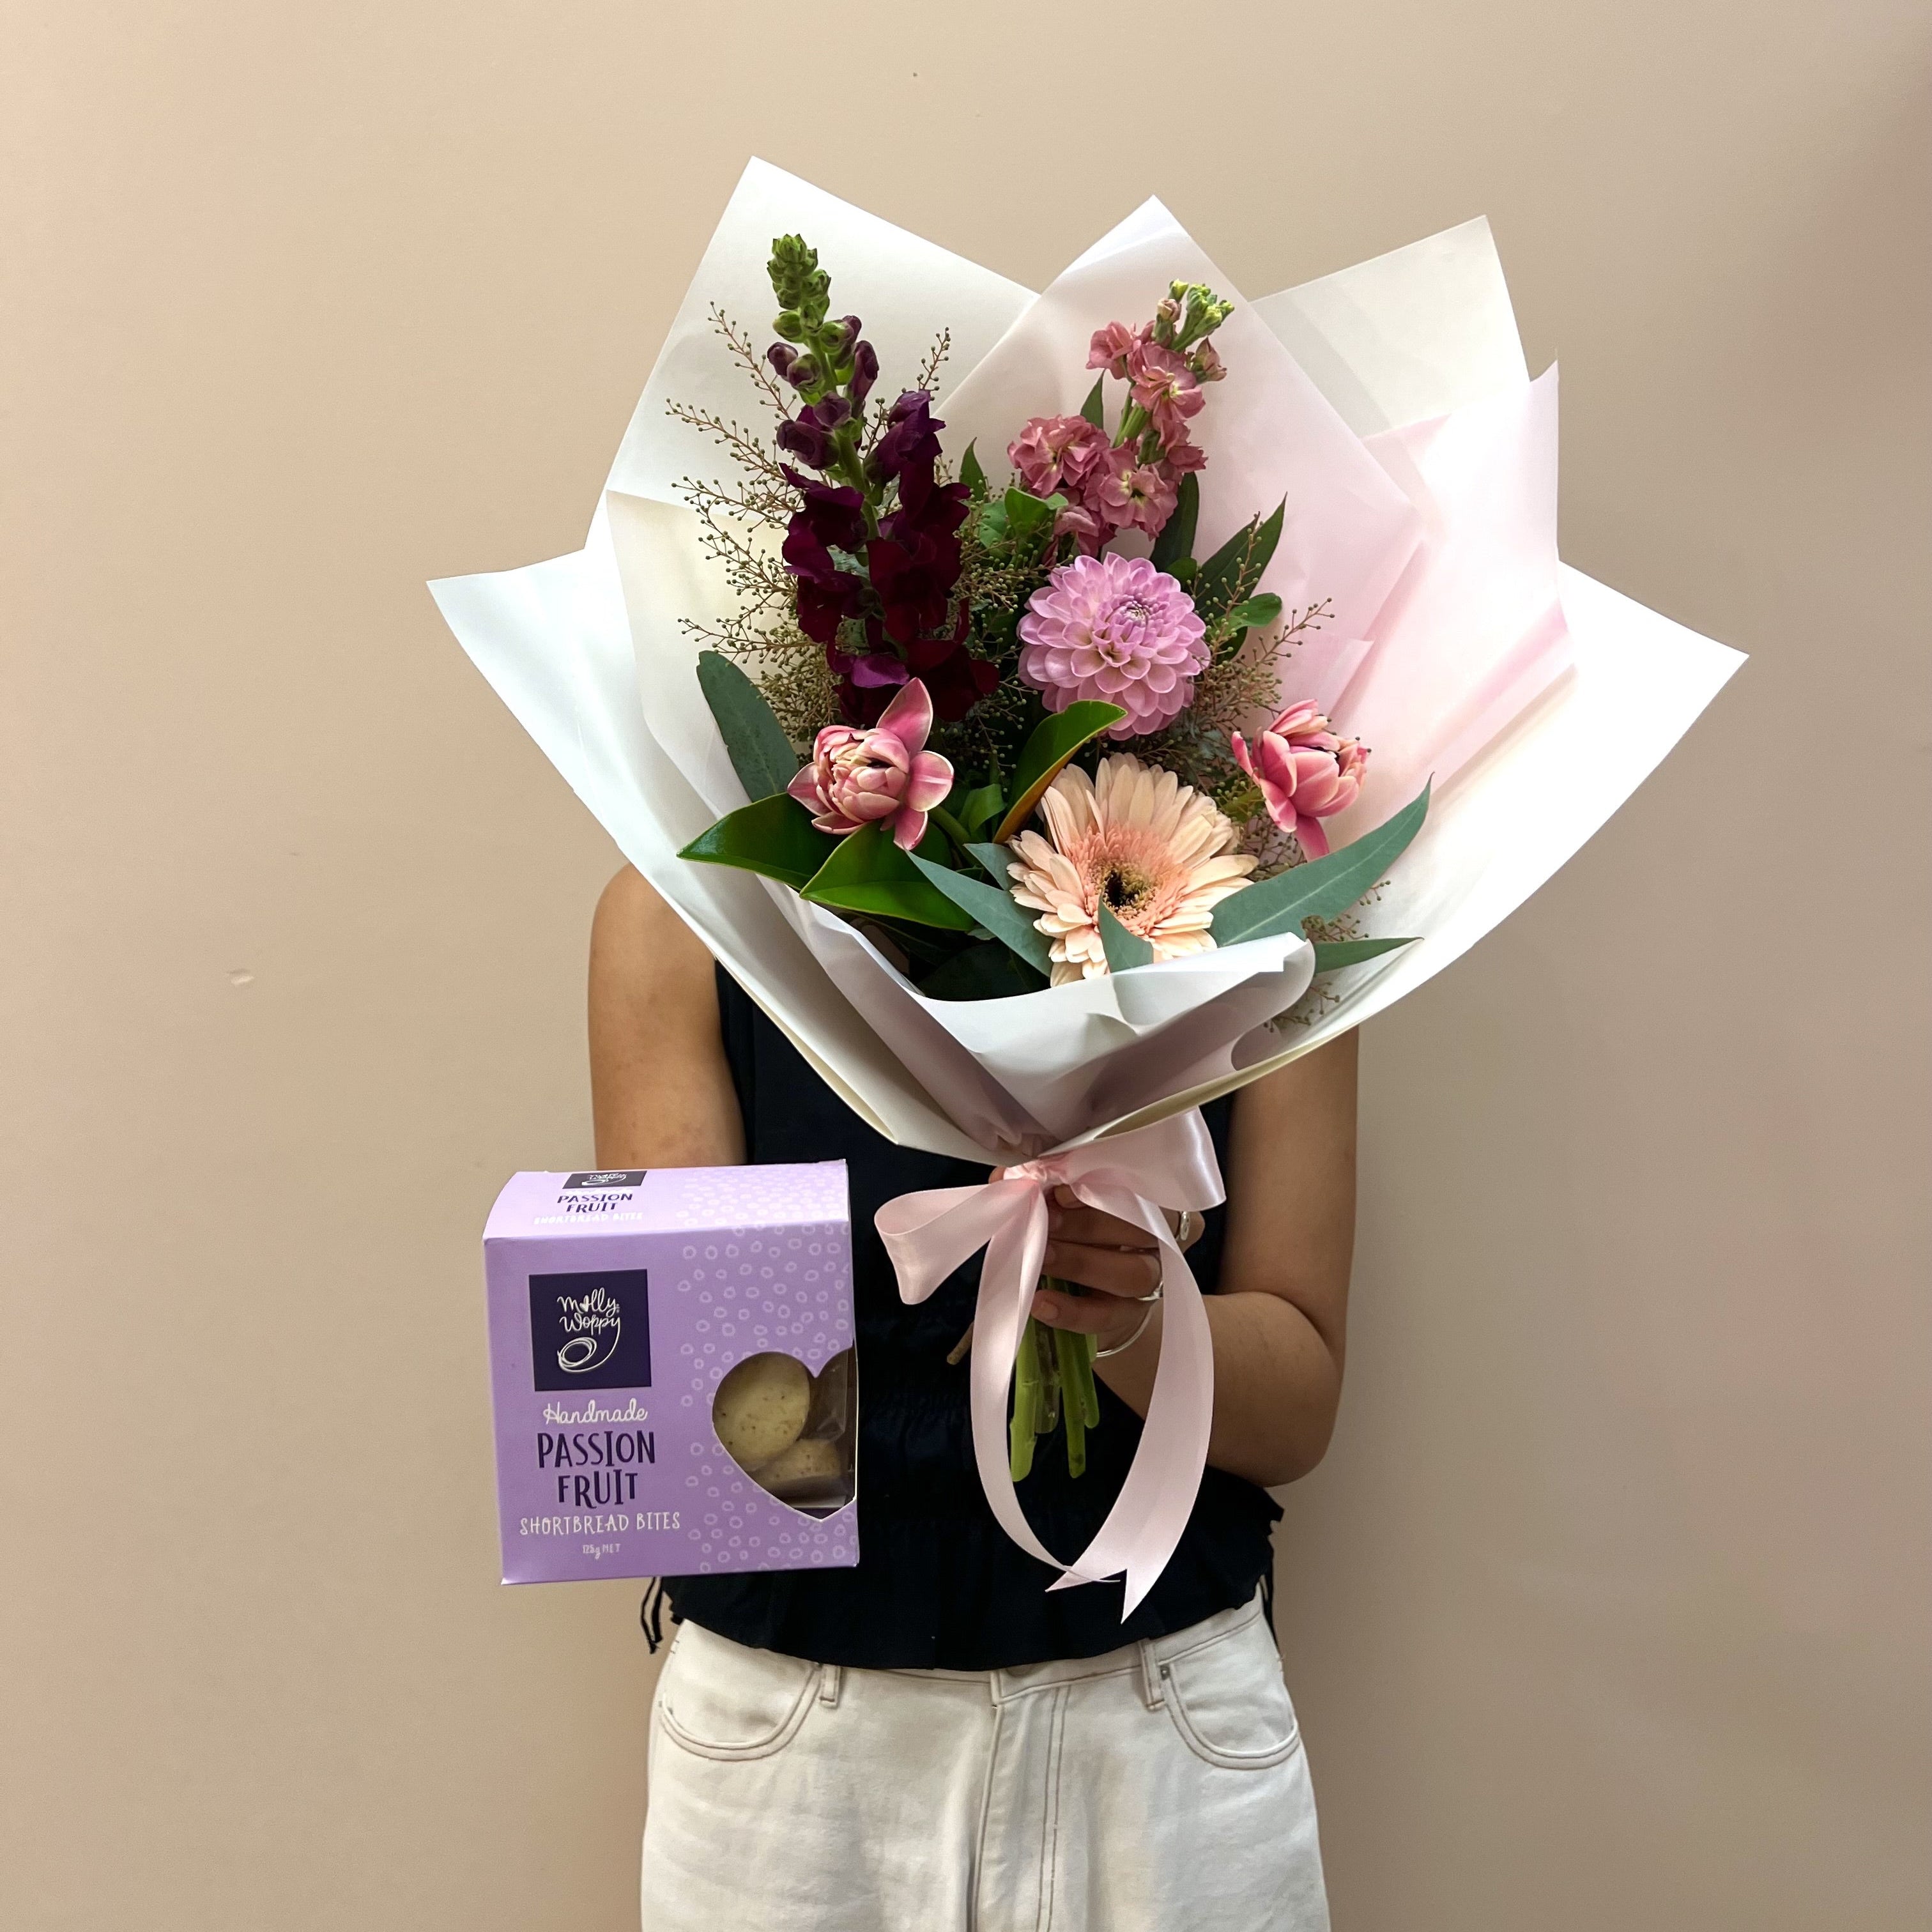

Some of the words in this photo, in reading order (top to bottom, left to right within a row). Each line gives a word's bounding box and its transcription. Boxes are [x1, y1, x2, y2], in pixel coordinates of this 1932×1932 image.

[557, 1193, 632, 1204] PASSION
[566, 1202, 618, 1213] FRUIT
[559, 1312, 621, 1336] Woppy
[542, 1398, 648, 1425] Handmade
[537, 1430, 656, 1468] PASSION
[558, 1469, 638, 1509] FRUIT
[519, 1514, 629, 1535] SHORTBREAD
[636, 1512, 680, 1531] BITES
[602, 1543, 621, 1553] NET
